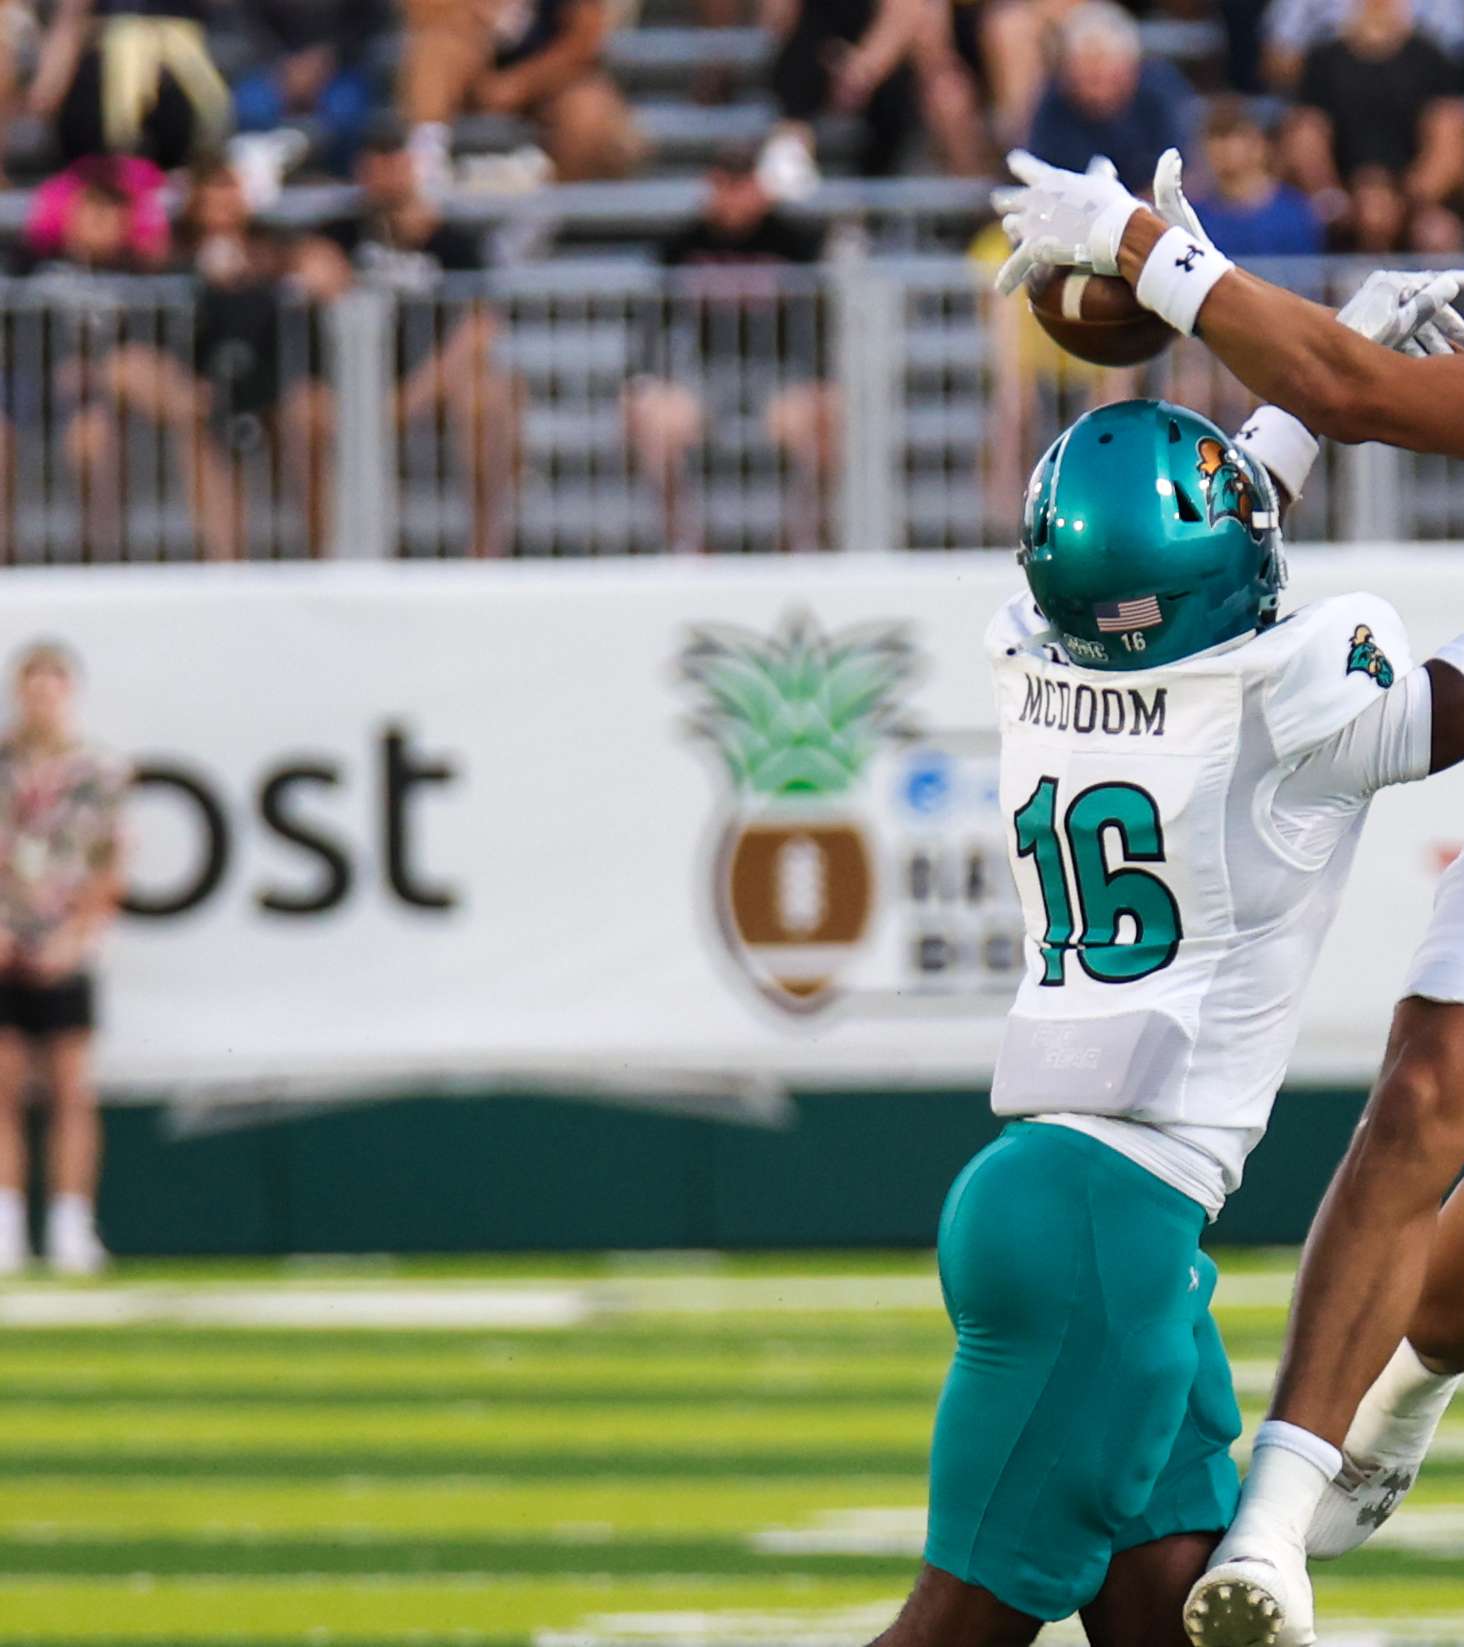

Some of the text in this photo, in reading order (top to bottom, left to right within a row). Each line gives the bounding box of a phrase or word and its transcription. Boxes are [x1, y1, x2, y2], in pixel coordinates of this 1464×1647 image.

[1120, 631, 1147, 653] 16
[1019, 672, 1168, 736] MCDOOM
[1013, 774, 1184, 988] 16
